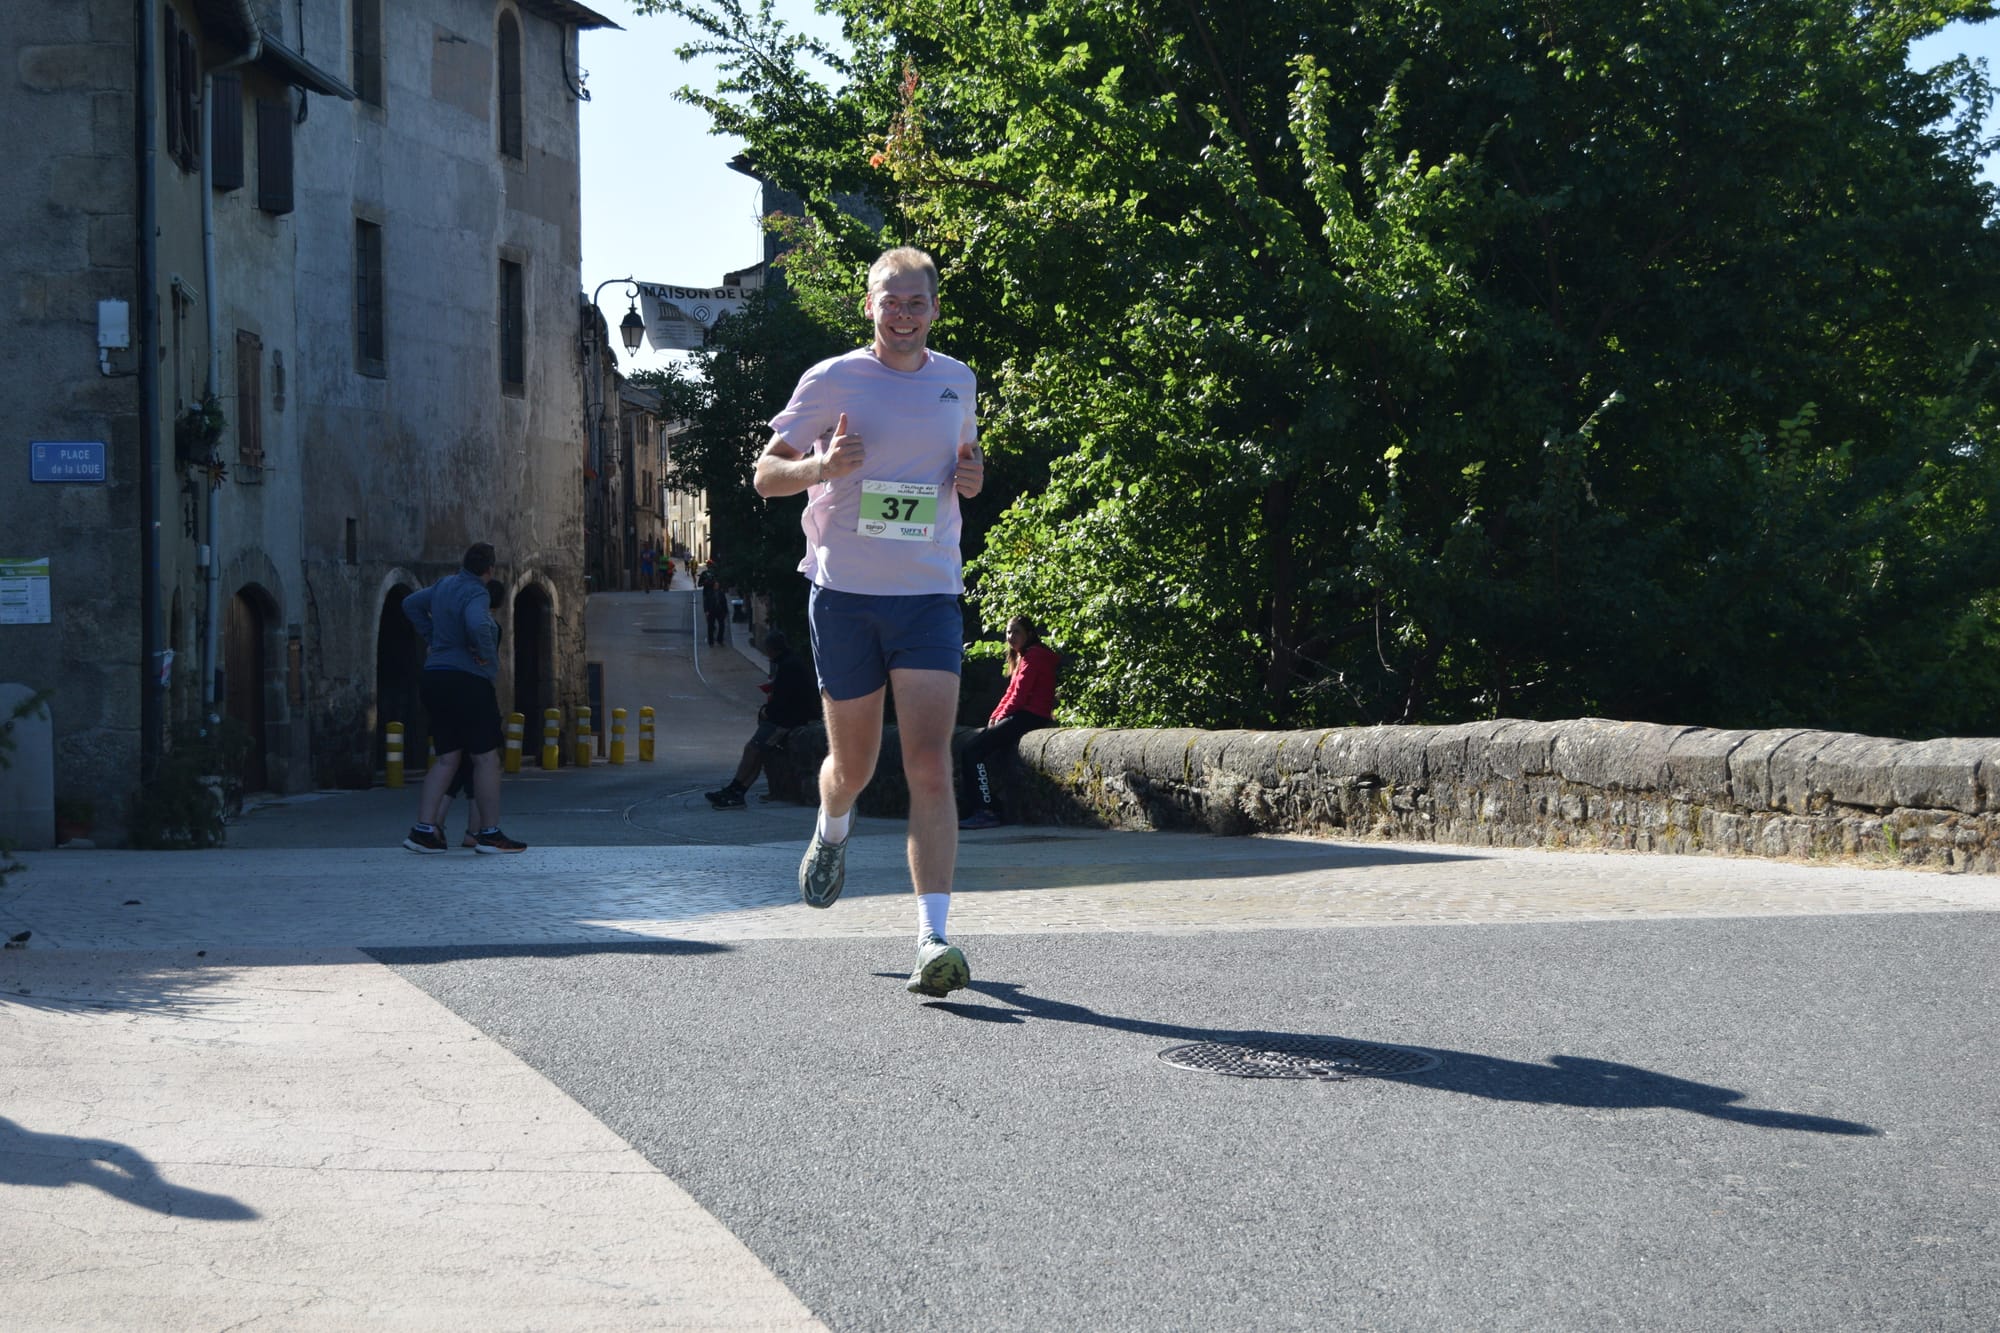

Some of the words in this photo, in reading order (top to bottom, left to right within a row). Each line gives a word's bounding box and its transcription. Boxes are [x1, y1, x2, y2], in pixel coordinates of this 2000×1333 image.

[643, 286, 709, 299] MAISON
[712, 289, 736, 299] DE
[60, 449, 90, 460] PLACE
[51, 464, 62, 474] de
[65, 464, 73, 474] la
[76, 464, 100, 474] LOUE
[881, 497, 919, 521] 37
[976, 762, 991, 803] adidas
